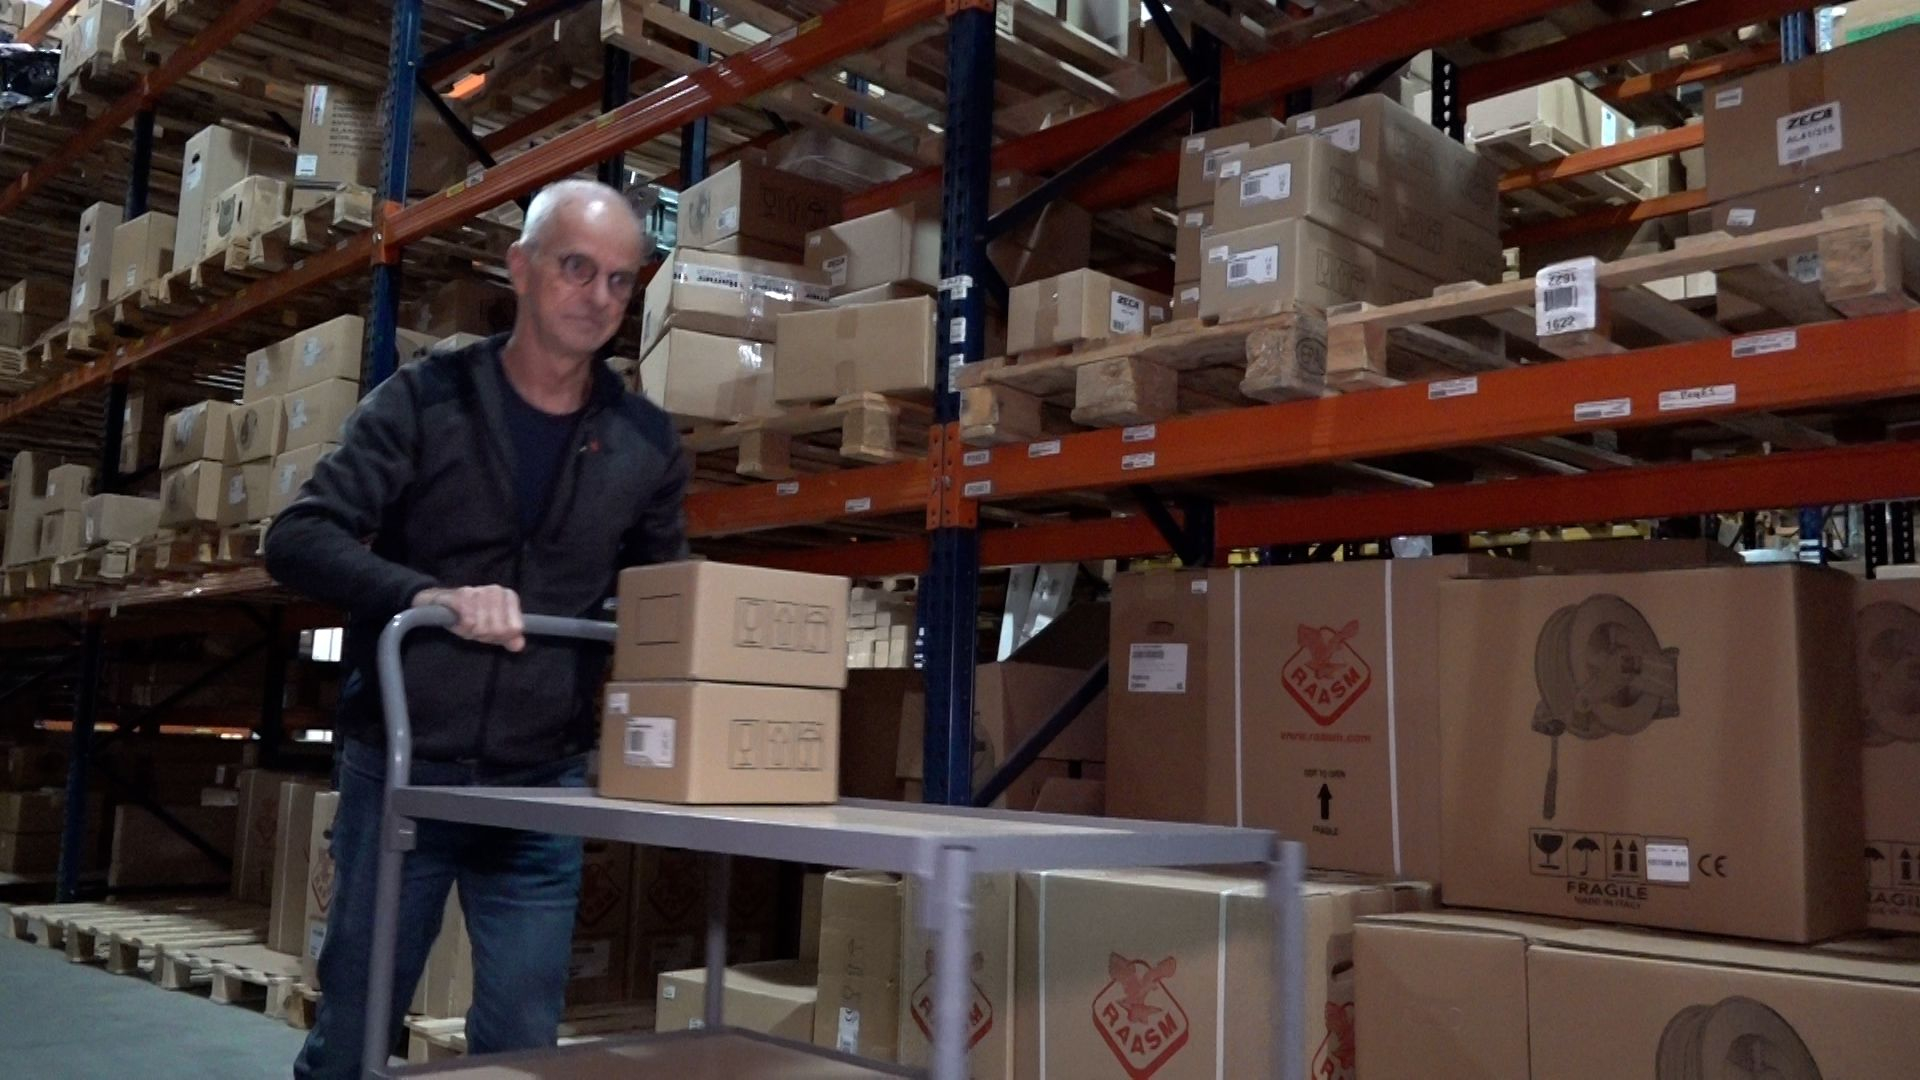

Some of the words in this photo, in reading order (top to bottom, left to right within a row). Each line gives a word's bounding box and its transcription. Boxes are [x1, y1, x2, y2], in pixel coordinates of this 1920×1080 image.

[1545, 315, 1575, 331] 1622
[1290, 666, 1361, 705] RAASM
[1566, 881, 1649, 901] FRAGILE
[1103, 1001, 1178, 1057] RAASM
